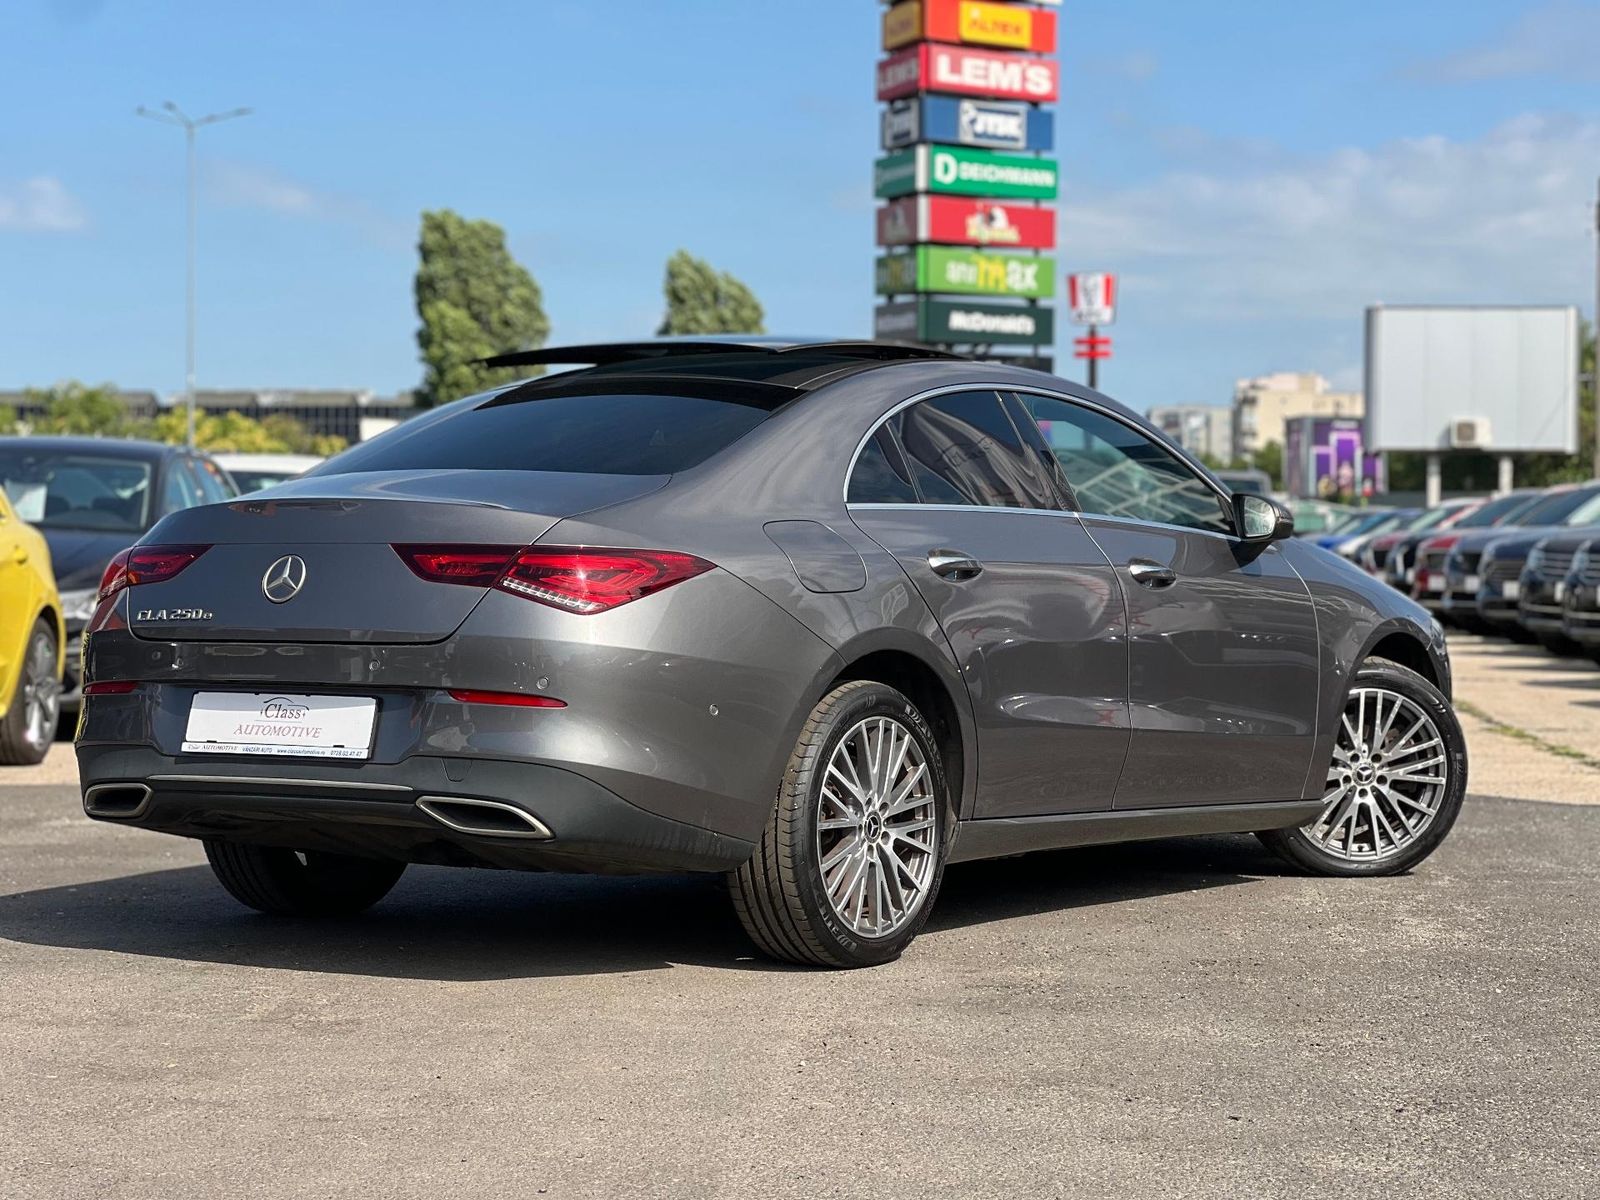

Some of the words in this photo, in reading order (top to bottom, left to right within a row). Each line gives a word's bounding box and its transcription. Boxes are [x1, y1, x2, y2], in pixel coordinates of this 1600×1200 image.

[937, 54, 1052, 95] LEM'S
[137, 609, 167, 620] CLA
[264, 703, 301, 719] Class
[233, 724, 323, 738] AUTOMOTIVE
